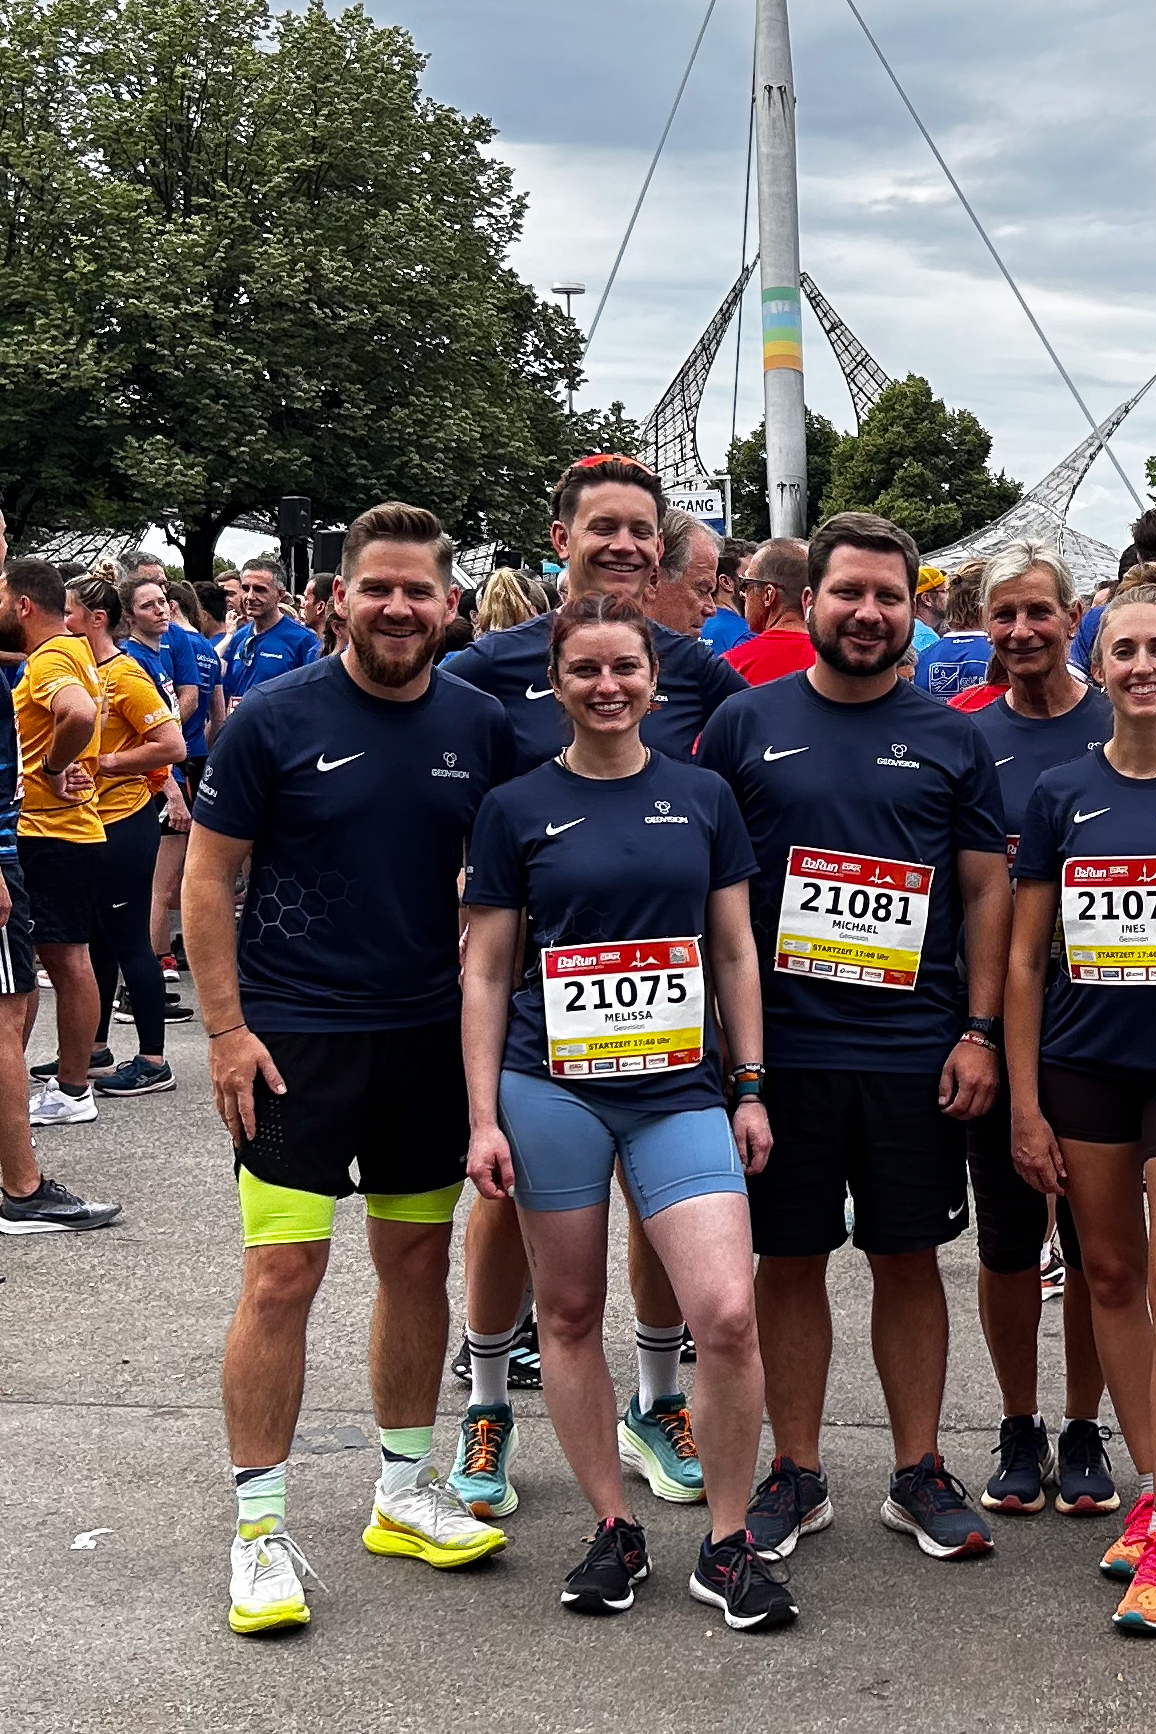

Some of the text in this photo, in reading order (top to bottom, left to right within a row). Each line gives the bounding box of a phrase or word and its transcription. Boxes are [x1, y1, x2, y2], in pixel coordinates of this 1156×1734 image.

[673, 499, 714, 512] GANG
[877, 757, 920, 769] GEOVISION
[431, 768, 470, 779] GEOVISION
[644, 816, 689, 824] GEOVISION
[800, 882, 912, 925] 21081
[832, 920, 878, 934] MICHAEL
[1122, 924, 1146, 933] INES
[813, 944, 852, 956] STARTZEIT
[564, 973, 687, 1012] 21075
[604, 1011, 653, 1023] MELISSA
[588, 1040, 631, 1051] STARTZEIT
